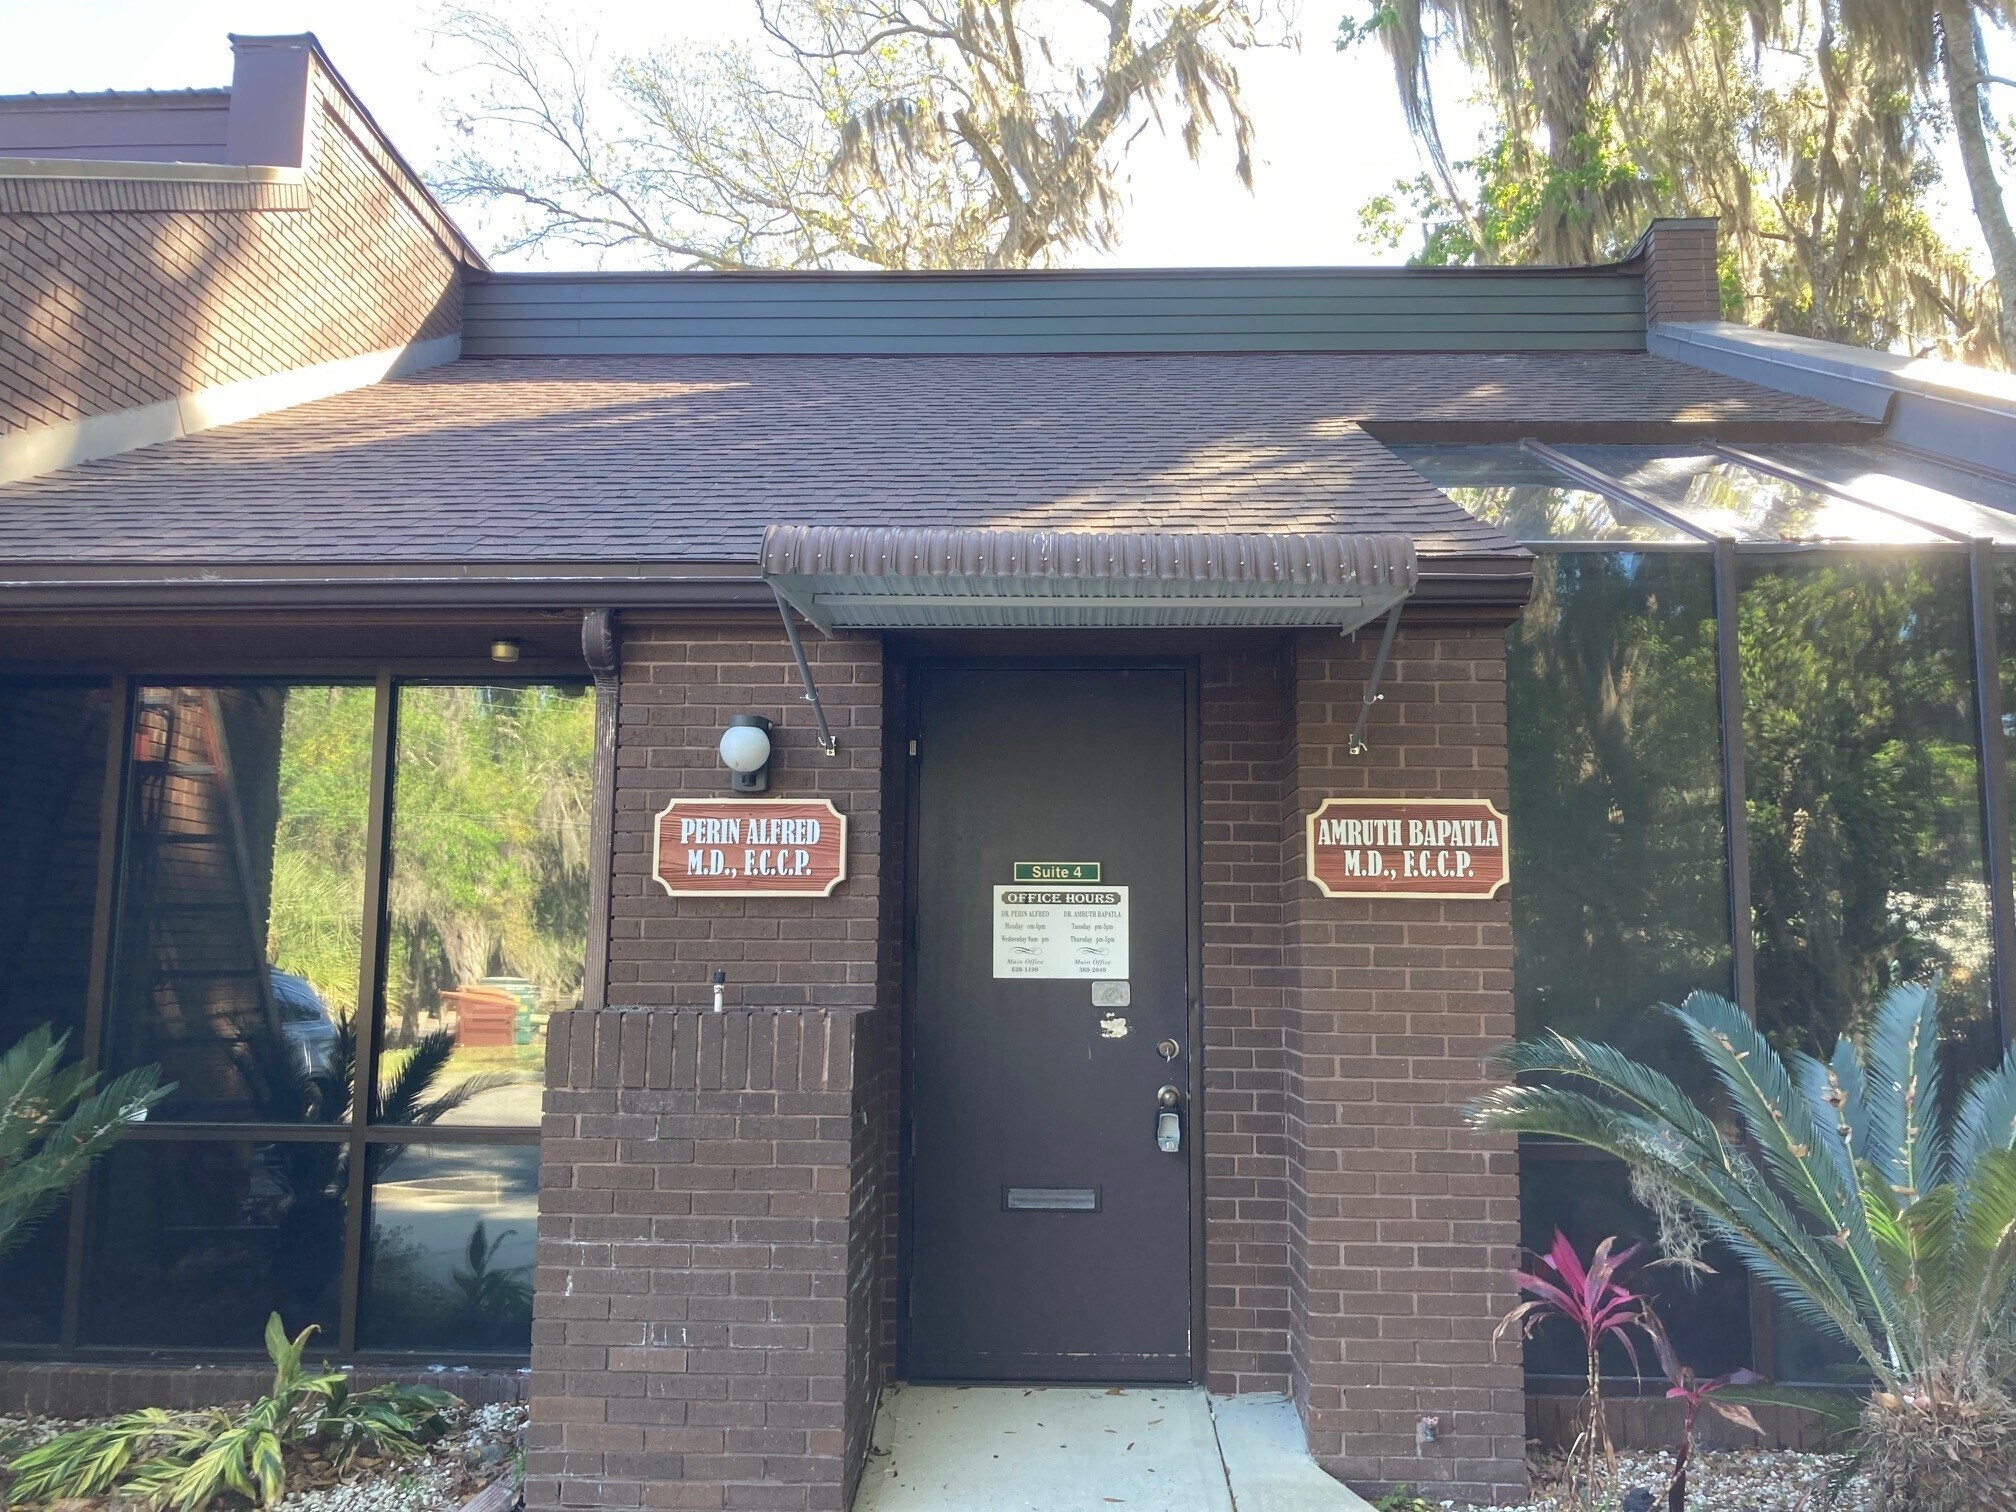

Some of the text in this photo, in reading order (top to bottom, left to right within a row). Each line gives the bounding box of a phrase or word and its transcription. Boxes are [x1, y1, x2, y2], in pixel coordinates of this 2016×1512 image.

[680, 818, 821, 845] PERIN ALFRED
[1317, 819, 1500, 847] AMRUTH BAPATLA
[687, 849, 812, 879] M.D., F.C.C.P.
[1344, 849, 1474, 880] M.D., F.C.C.P.
[1032, 865, 1082, 878] Suite 4
[1007, 893, 1115, 904] OFFICE HOURS
[1006, 922, 1024, 930] Monday
[1072, 922, 1090, 930] Tuesday
[1070, 936, 1092, 944] Thursday
